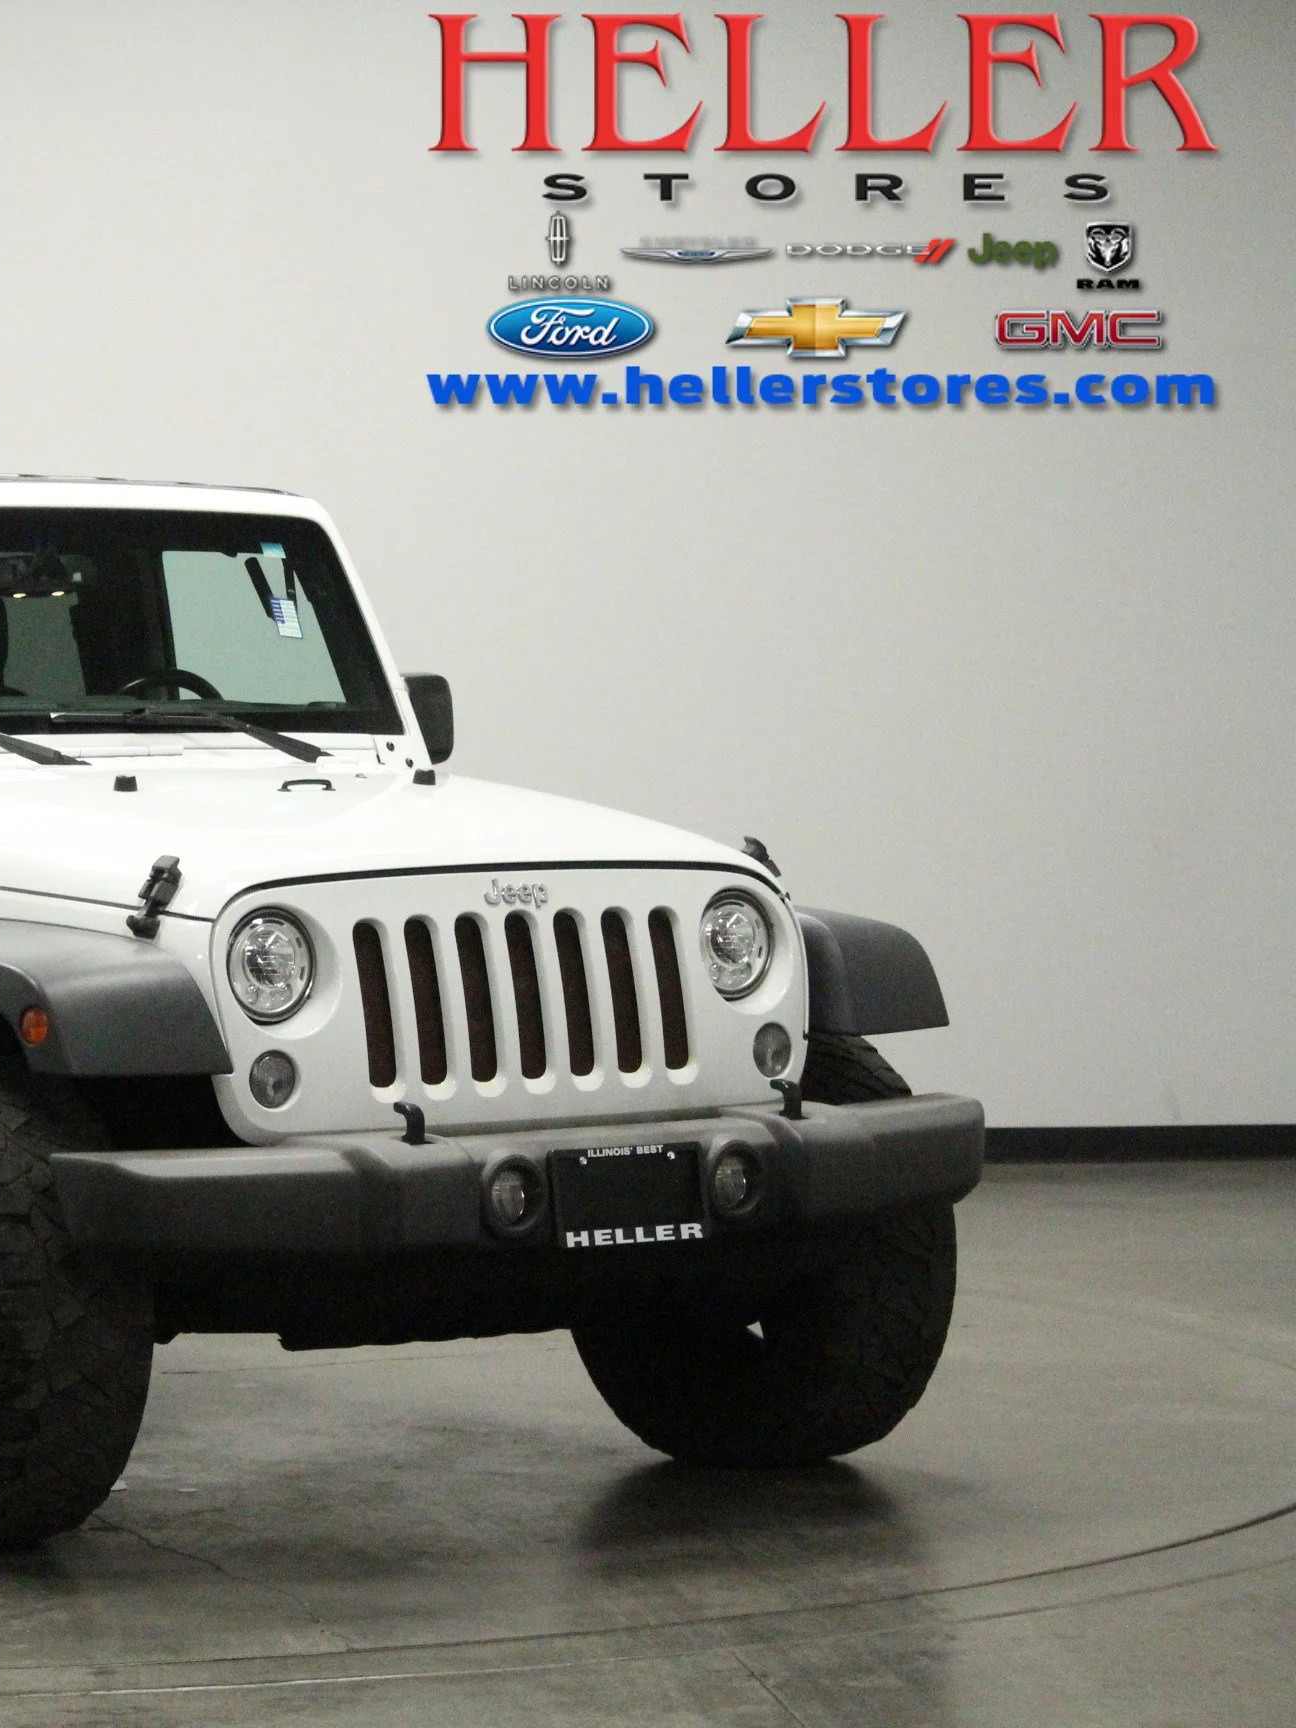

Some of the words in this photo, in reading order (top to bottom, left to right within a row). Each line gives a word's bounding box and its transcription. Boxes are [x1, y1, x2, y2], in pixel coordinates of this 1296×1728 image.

[484, 878, 549, 909] Jeep
[636, 1144, 664, 1155] BEST
[565, 1222, 703, 1248] HELLER
